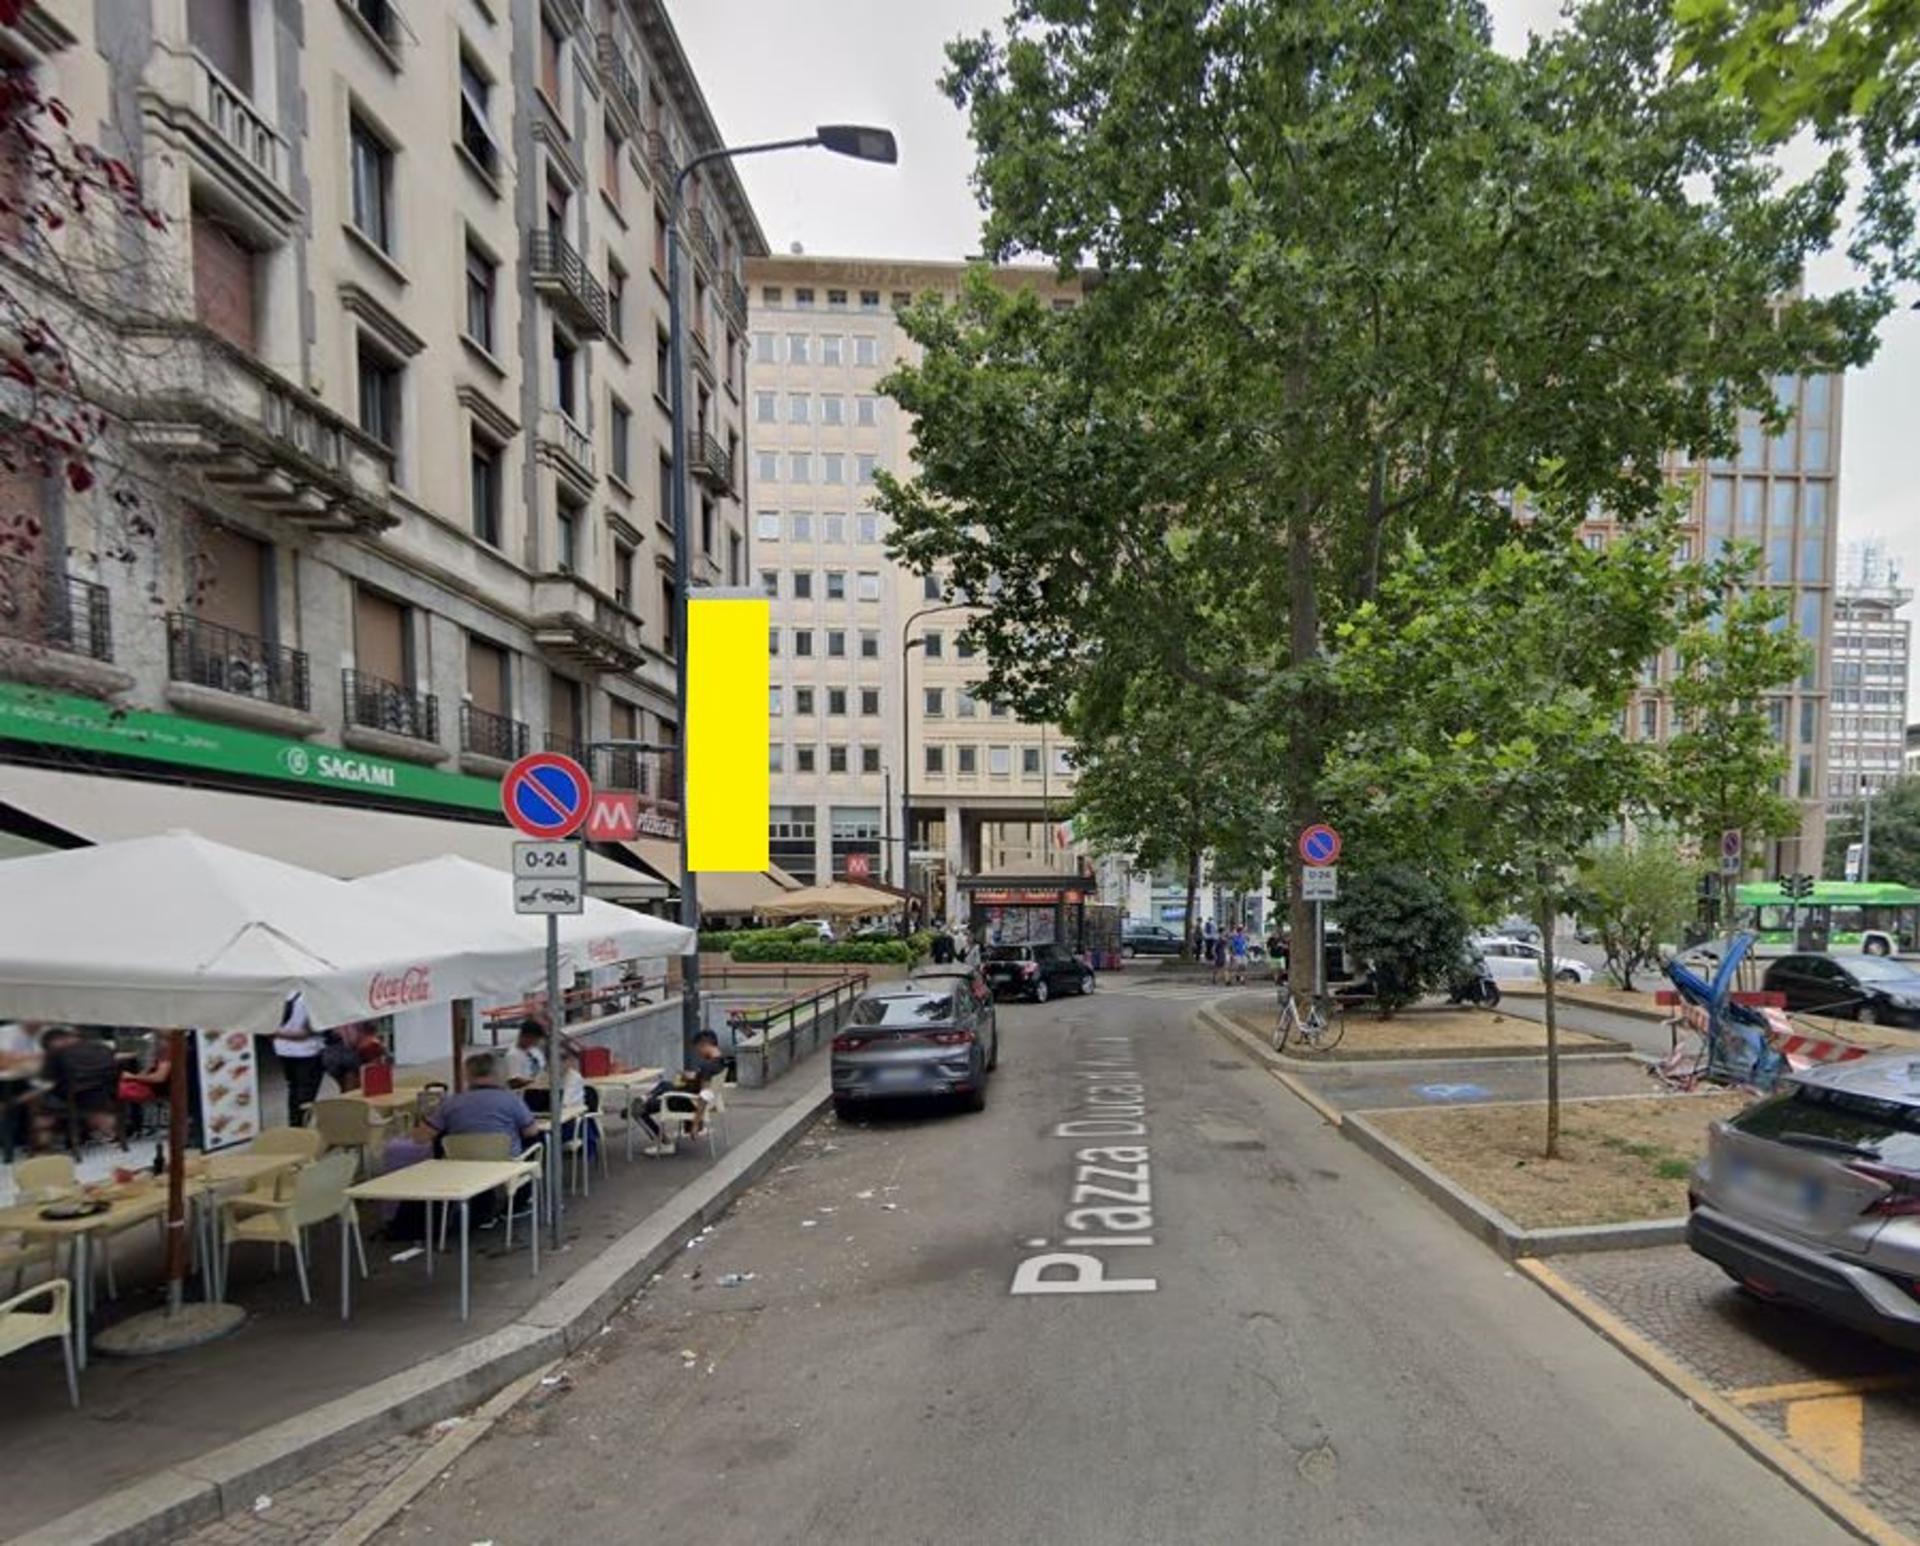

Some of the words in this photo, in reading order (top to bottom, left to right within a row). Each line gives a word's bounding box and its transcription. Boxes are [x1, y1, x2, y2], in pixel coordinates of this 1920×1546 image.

[317, 755, 395, 786] SAGAMI
[592, 802, 632, 830] M
[525, 851, 568, 868] 0-24
[849, 856, 869, 873] M
